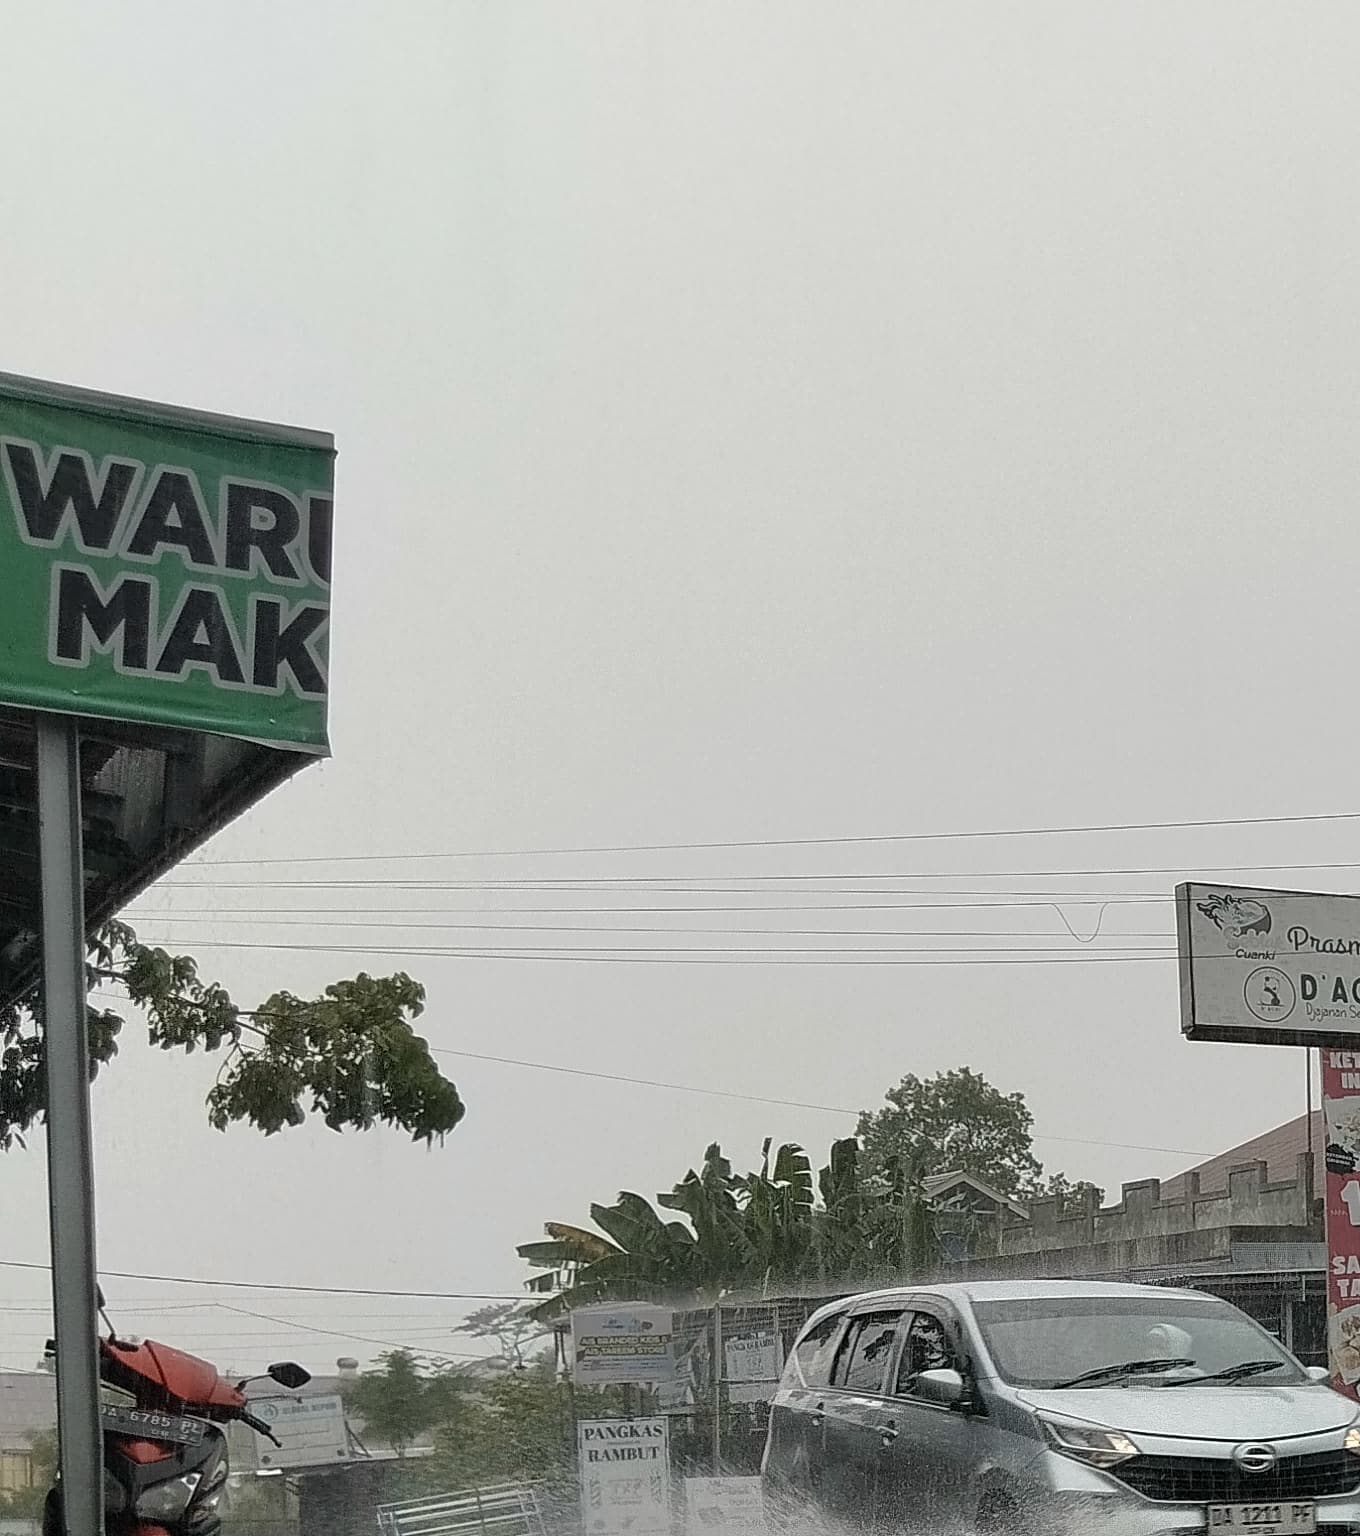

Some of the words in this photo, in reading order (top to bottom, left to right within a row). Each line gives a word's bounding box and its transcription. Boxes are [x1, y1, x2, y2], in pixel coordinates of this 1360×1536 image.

[1235, 949, 1276, 960] Cuanki
[130, 1411, 171, 1427] 6785
[583, 1424, 664, 1440] PANGKAS
[588, 1446, 660, 1462] RAMBUT
